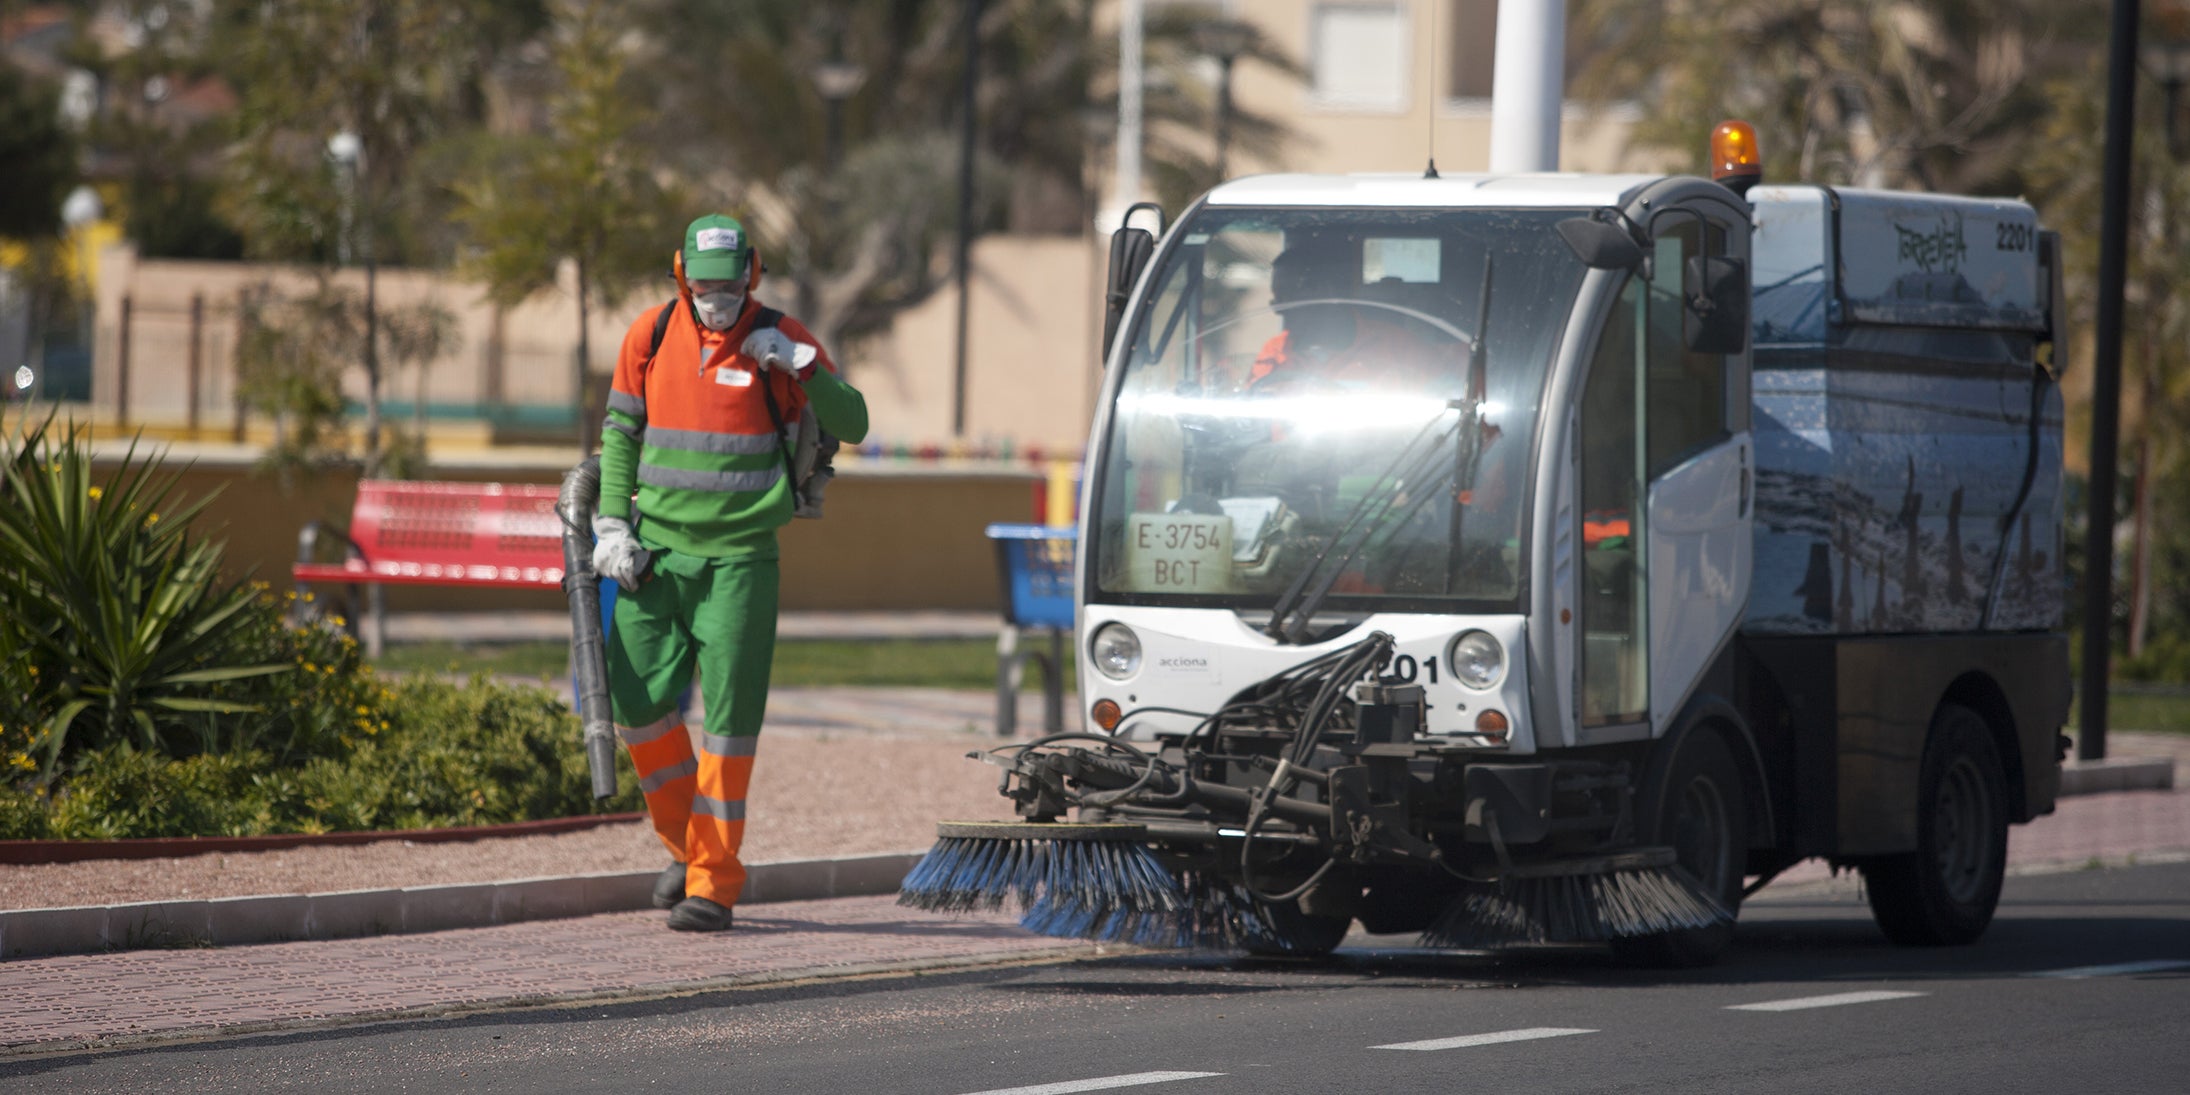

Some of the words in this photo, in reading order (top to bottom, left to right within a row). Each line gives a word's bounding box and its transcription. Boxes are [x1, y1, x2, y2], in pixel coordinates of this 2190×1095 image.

[1996, 222, 2034, 252] 2201
[1154, 559, 1201, 585] BCT
[1159, 656, 1208, 667] acciona
